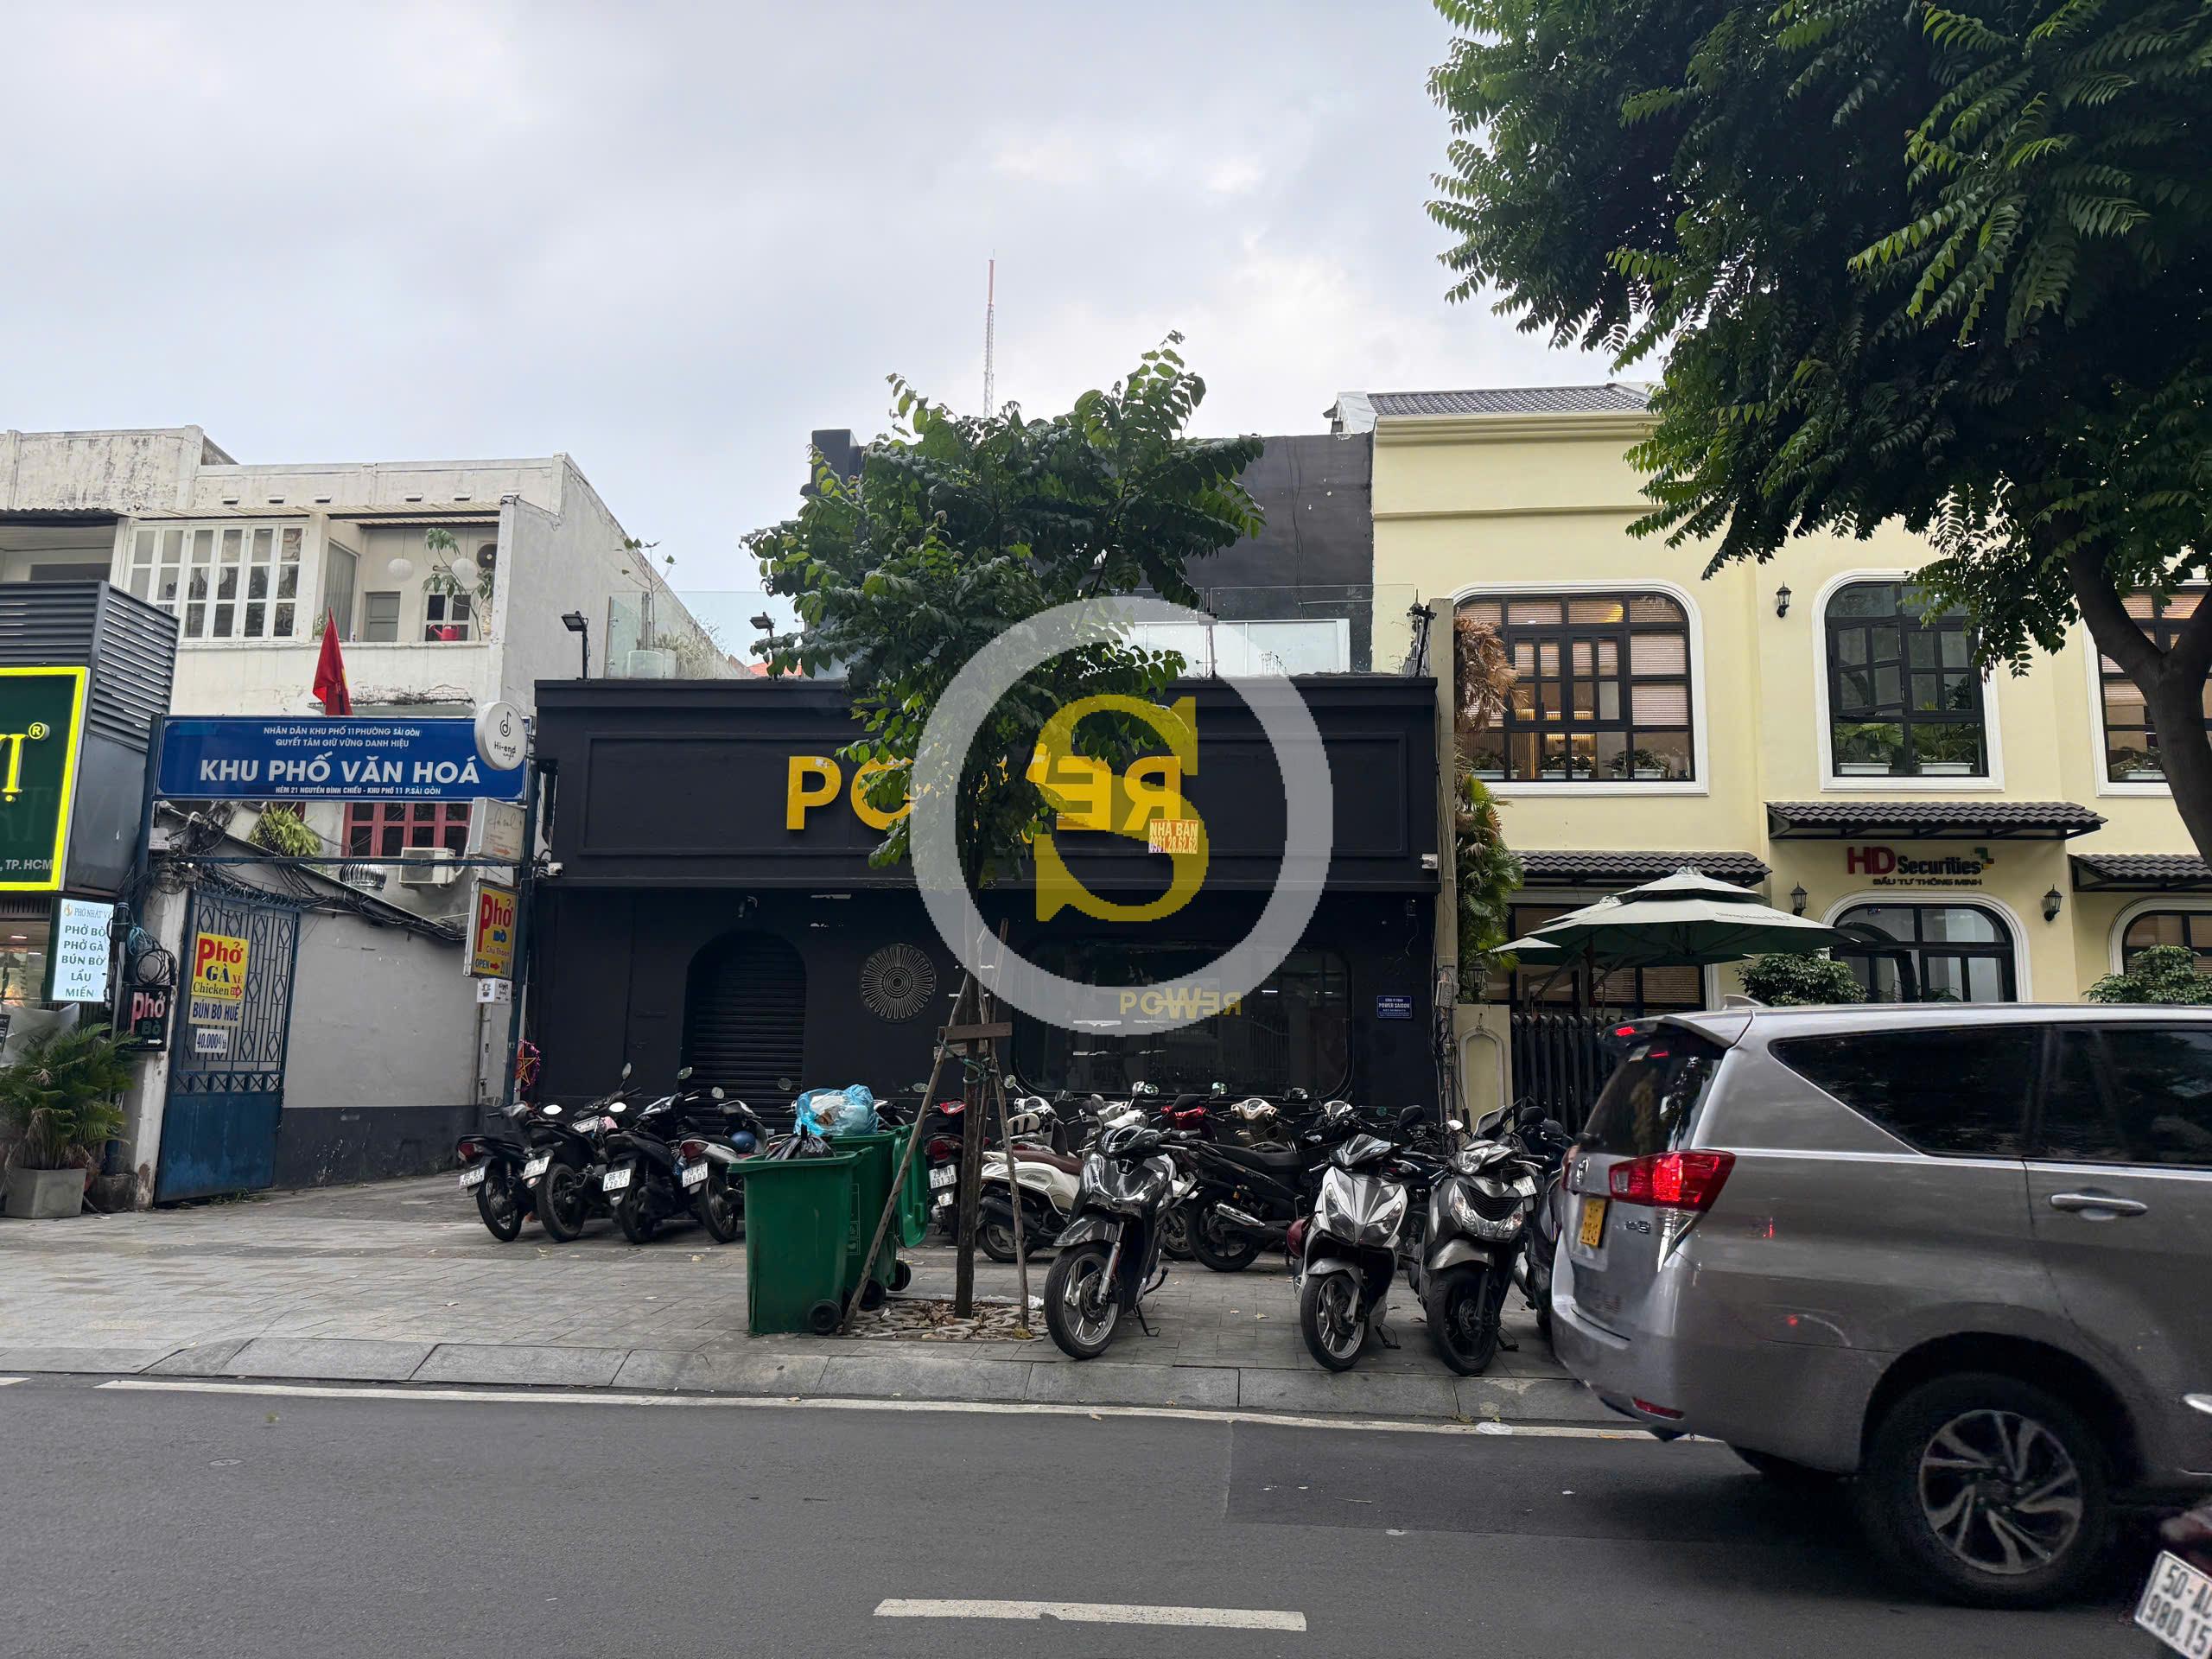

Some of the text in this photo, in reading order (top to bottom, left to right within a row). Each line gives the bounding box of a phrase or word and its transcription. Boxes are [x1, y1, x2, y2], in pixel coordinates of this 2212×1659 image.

[309, 727, 327, 735] KHU
[200, 750, 480, 784] KHU PHỐ VĂN HOÁ
[1847, 847, 1982, 875] HD Securities
[89, 940, 104, 951] GÀ
[61, 954, 86, 965] BÚN
[196, 938, 244, 977] Phở
[206, 963, 230, 983] GÀ
[193, 982, 230, 995] Chicken
[193, 999, 210, 1019] BÚN
[211, 1001, 222, 1020] BÒ
